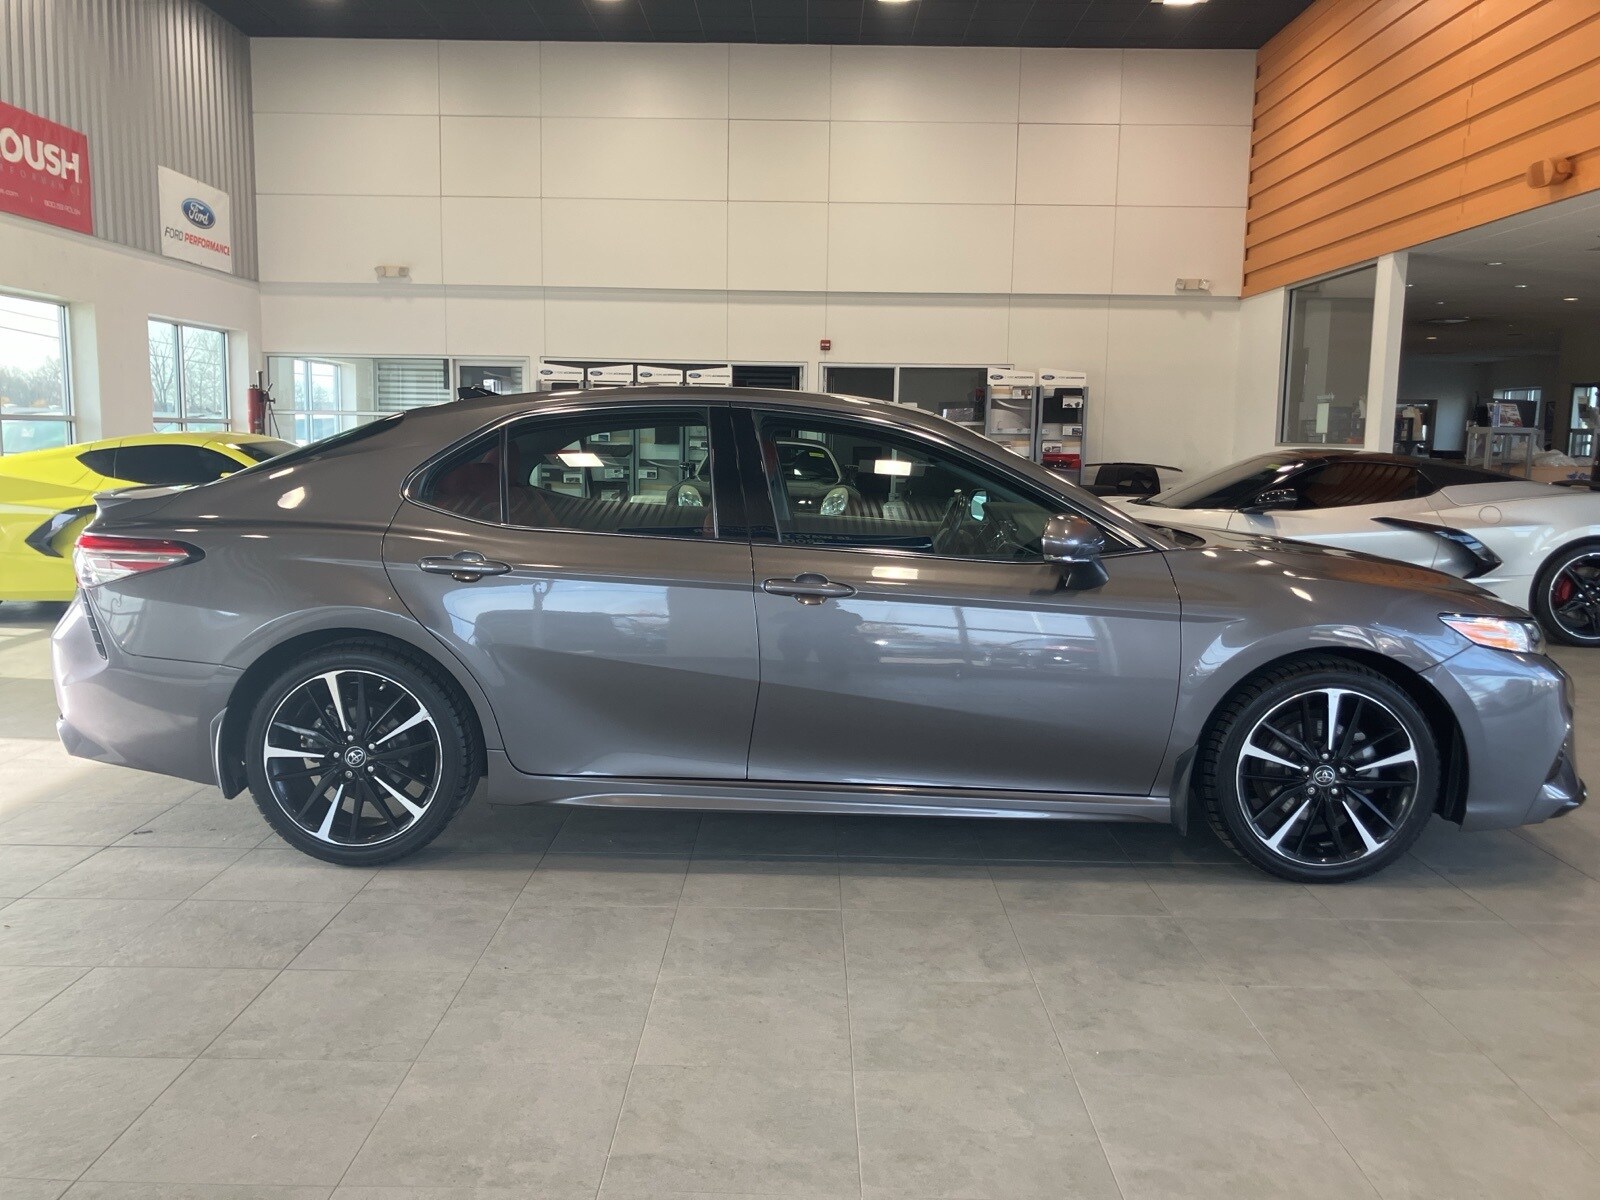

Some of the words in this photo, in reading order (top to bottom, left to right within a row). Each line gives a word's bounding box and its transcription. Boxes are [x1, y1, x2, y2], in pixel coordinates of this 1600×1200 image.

[0, 127, 80, 184] OUSH
[188, 202, 209, 225] Ford
[164, 226, 184, 241] FORD
